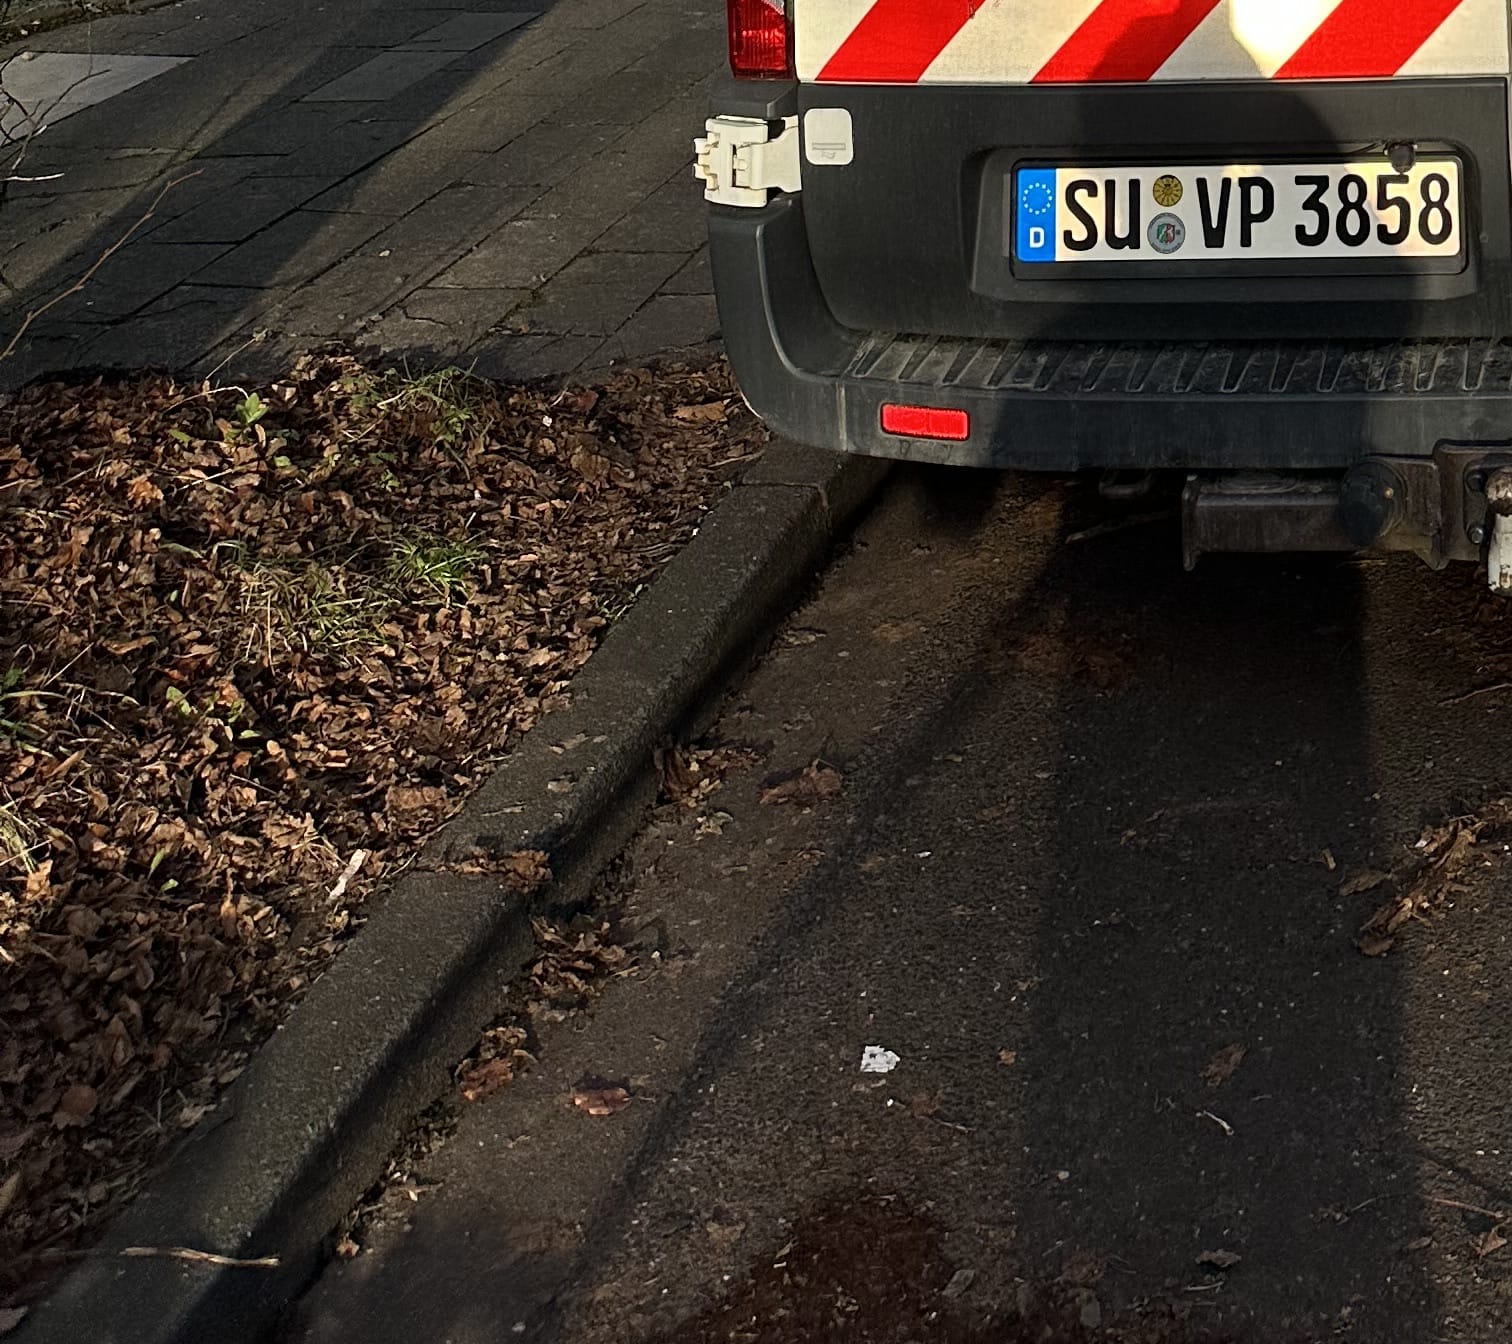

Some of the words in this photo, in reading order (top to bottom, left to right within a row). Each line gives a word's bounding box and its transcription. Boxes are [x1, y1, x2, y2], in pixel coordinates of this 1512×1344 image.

[1063, 179, 1141, 252] SU
[1195, 176, 1275, 249] VP
[1294, 173, 1453, 247] 3858
[1029, 227, 1045, 249] D
